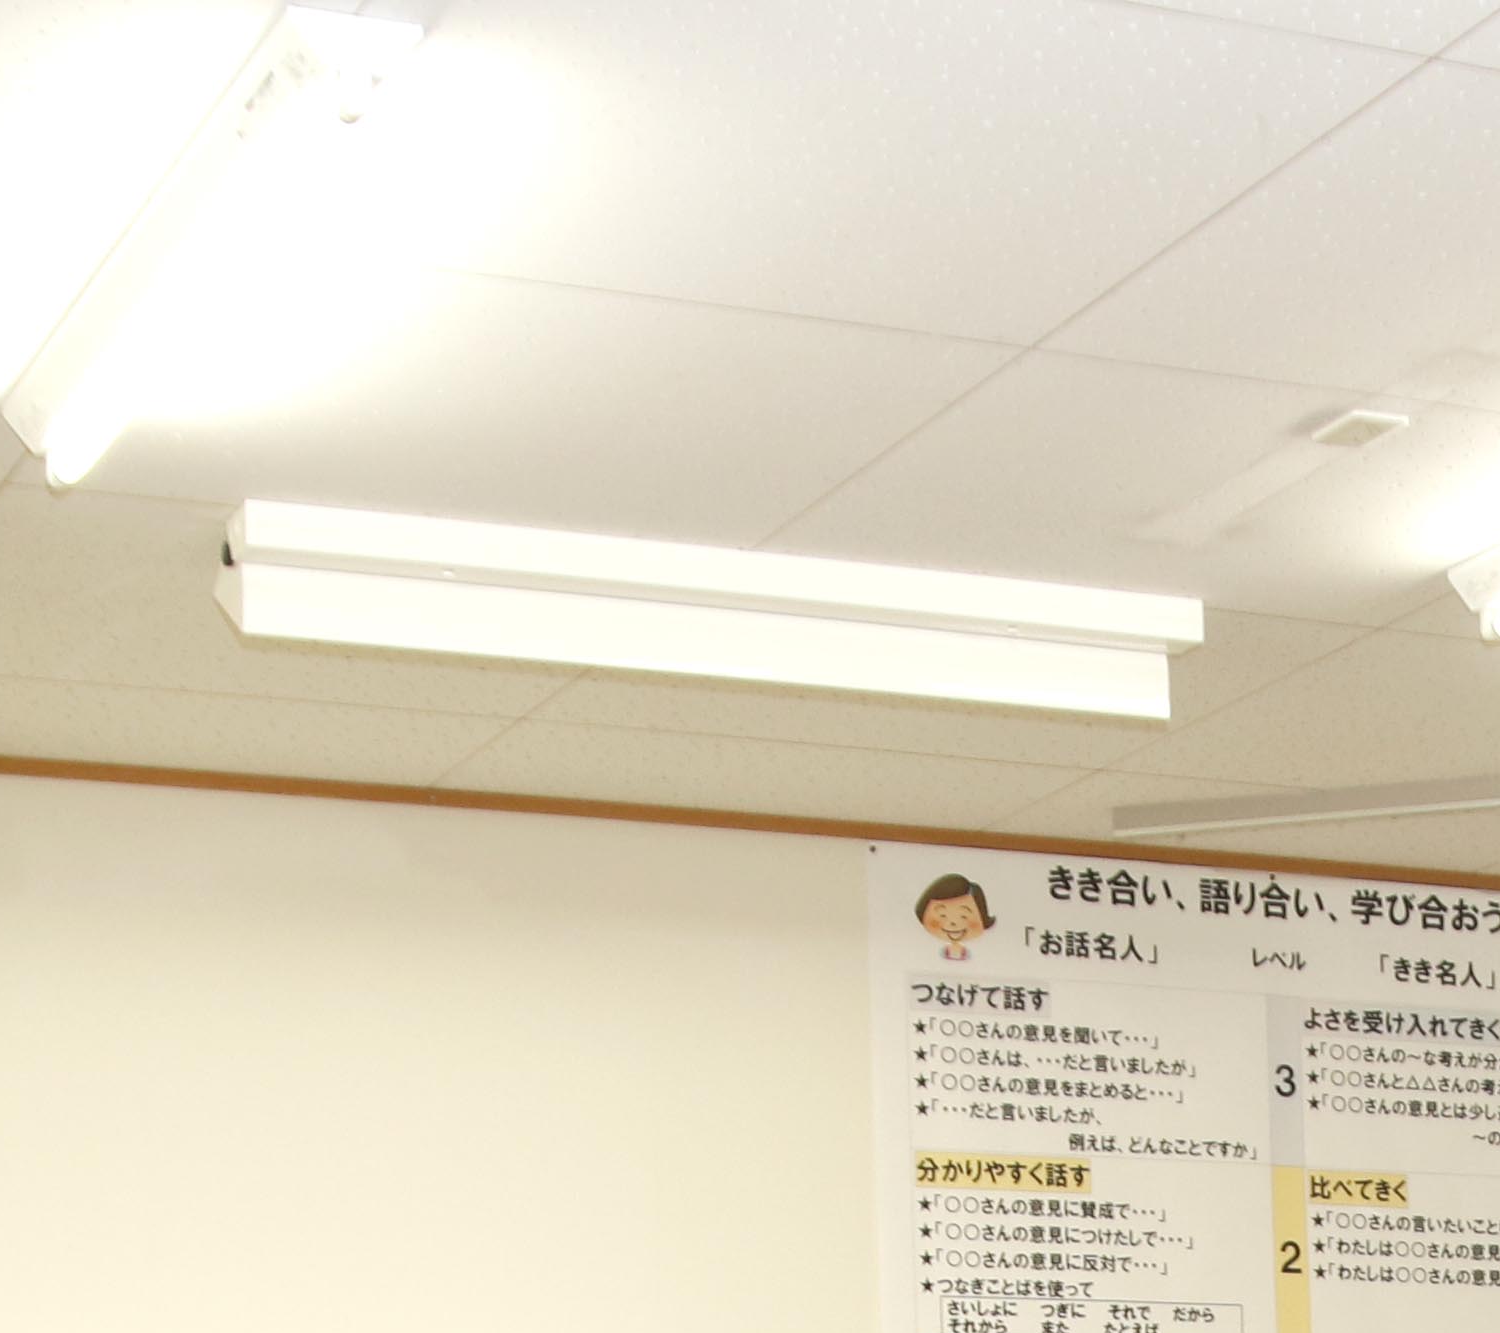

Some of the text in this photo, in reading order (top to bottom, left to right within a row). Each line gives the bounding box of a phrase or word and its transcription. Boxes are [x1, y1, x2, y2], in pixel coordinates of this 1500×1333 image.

[1023, 926, 1160, 965] 「お話名人」
[1252, 948, 1306, 971] レベル
[1380, 953, 1496, 990] 「きき名人」
[911, 982, 1049, 1011] つなげて話す
[1303, 1007, 1500, 1041] よさを受け入れてきく
[1274, 1063, 1297, 1098] 3
[916, 1158, 1091, 1188] 分かりやすく話す
[1309, 1175, 1408, 1202] 比べてきく
[1279, 1241, 1303, 1275] 2
[947, 1301, 1215, 1322] さいしょに つぎに それで だから
